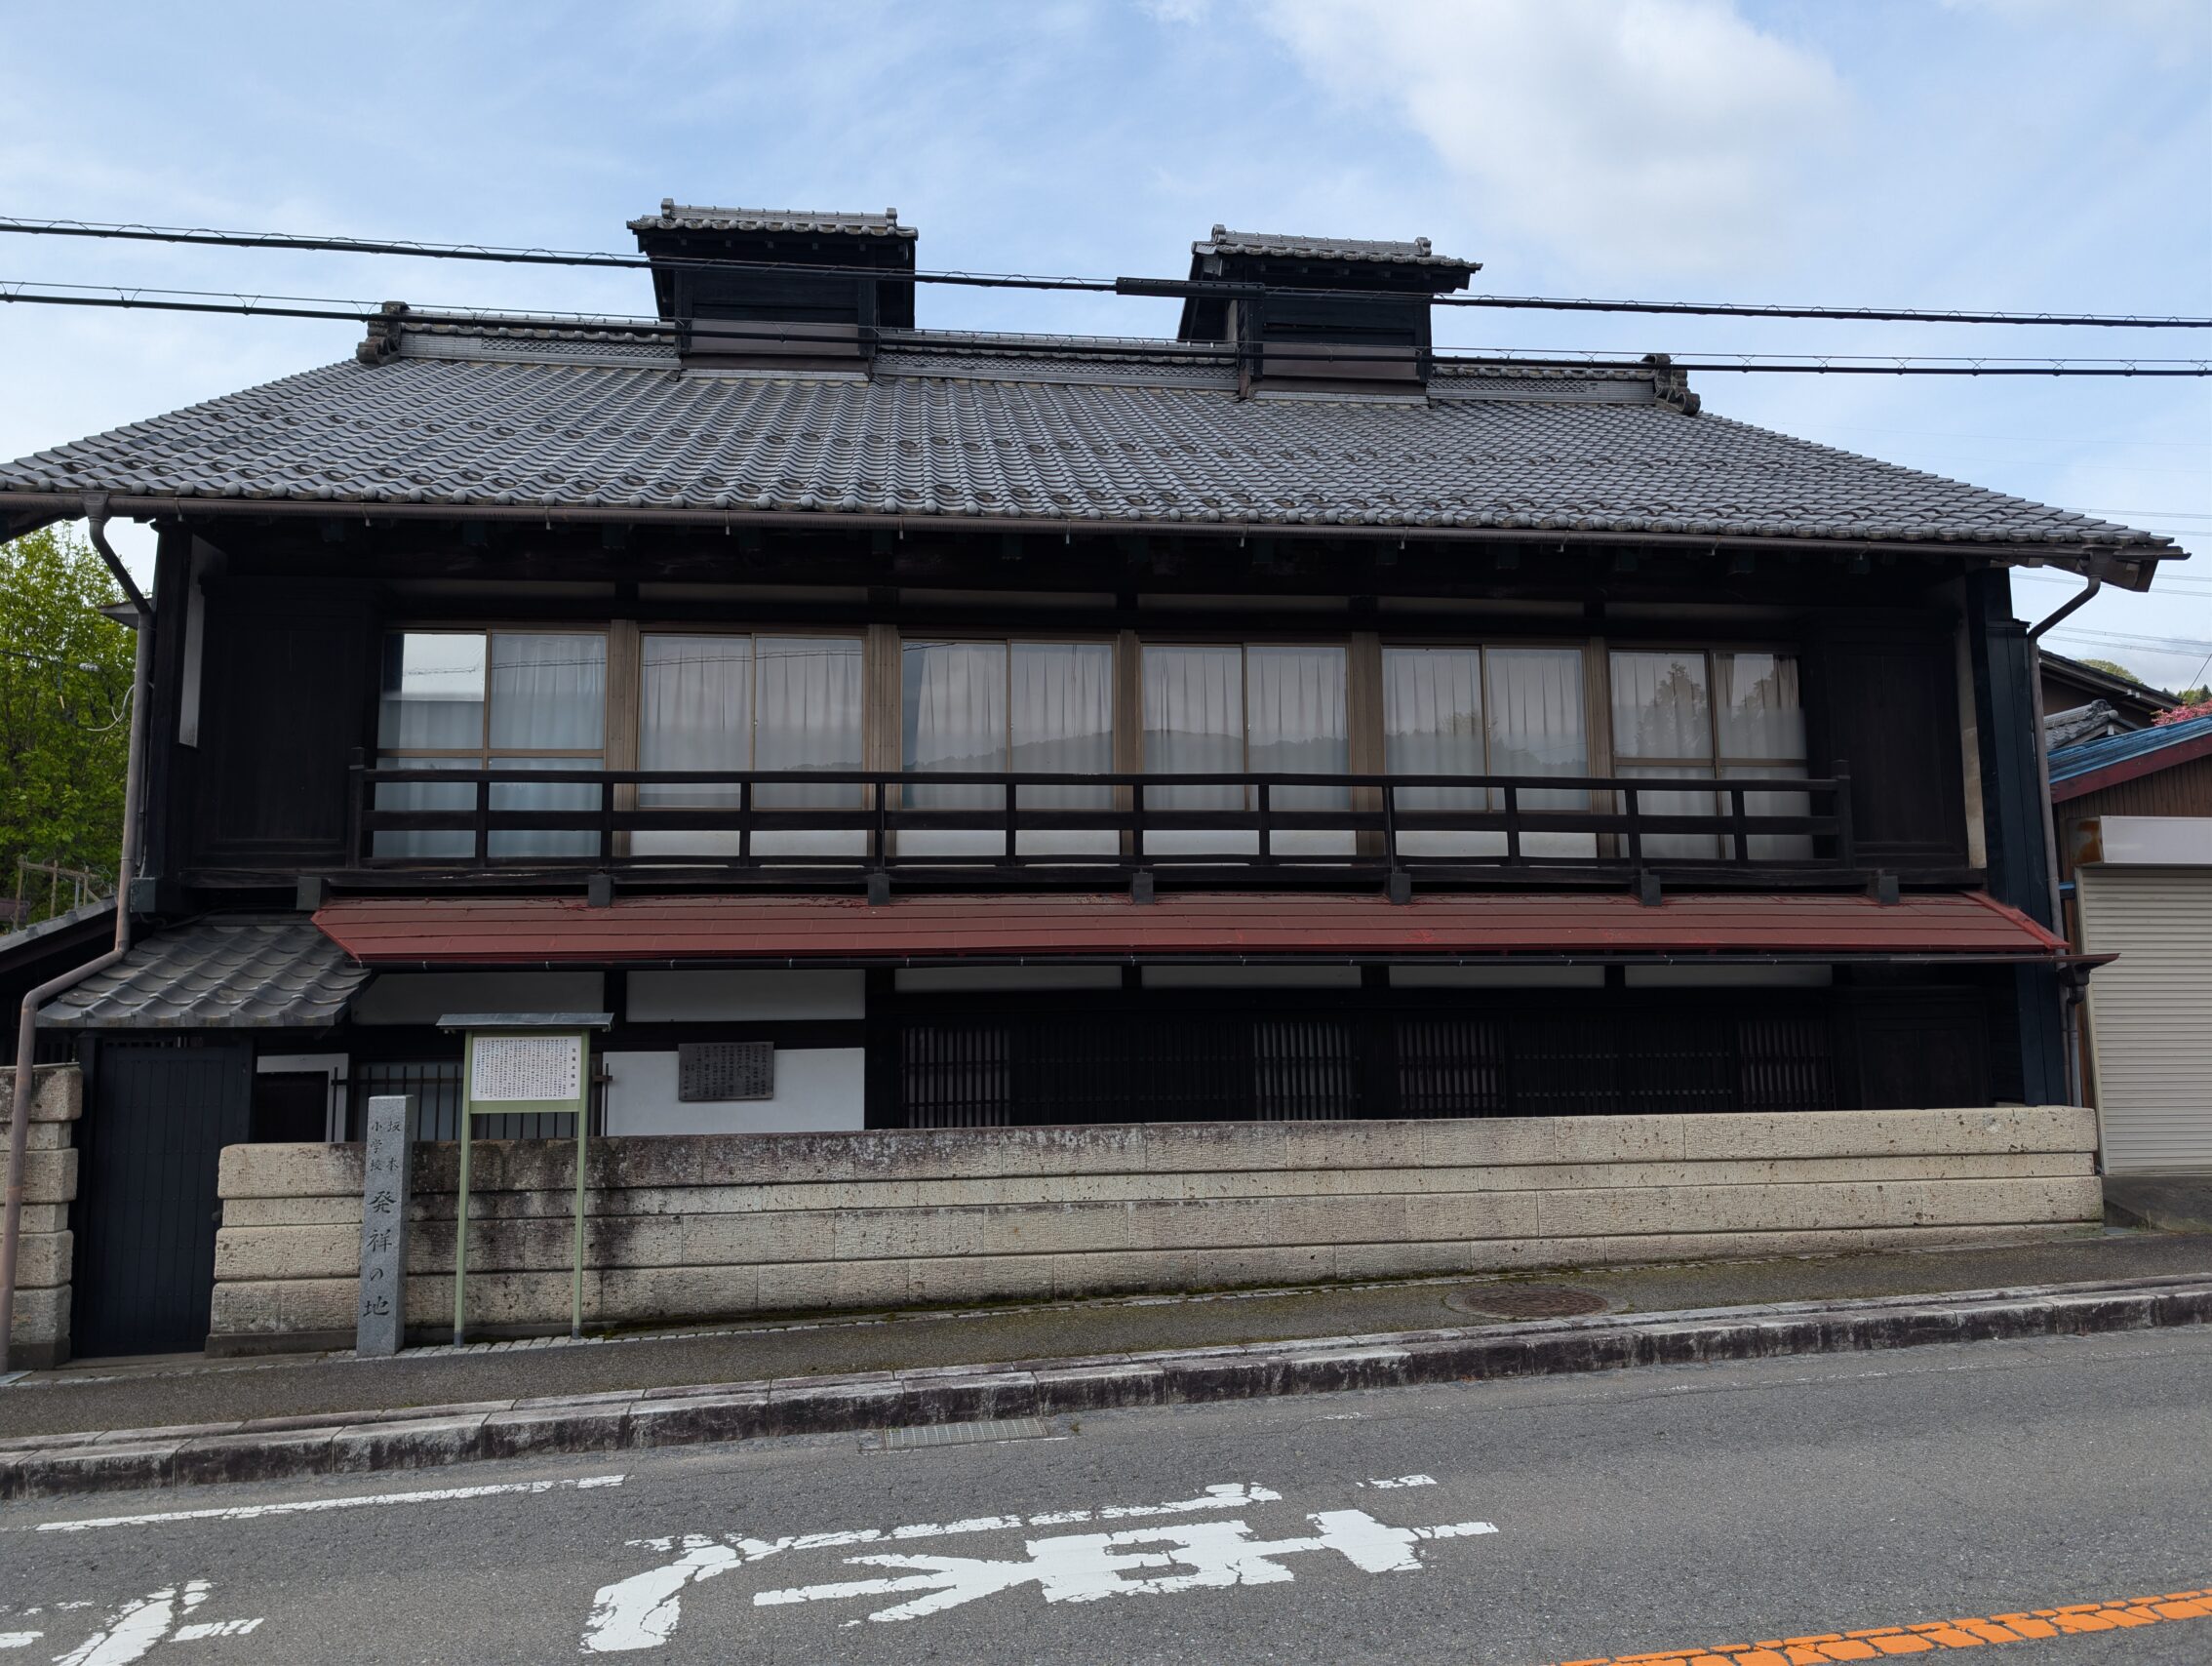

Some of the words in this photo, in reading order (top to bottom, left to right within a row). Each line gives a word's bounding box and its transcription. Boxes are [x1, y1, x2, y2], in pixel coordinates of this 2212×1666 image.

[370, 1121, 383, 1171] 小学校
[363, 1190, 397, 1317] 発祥の地
